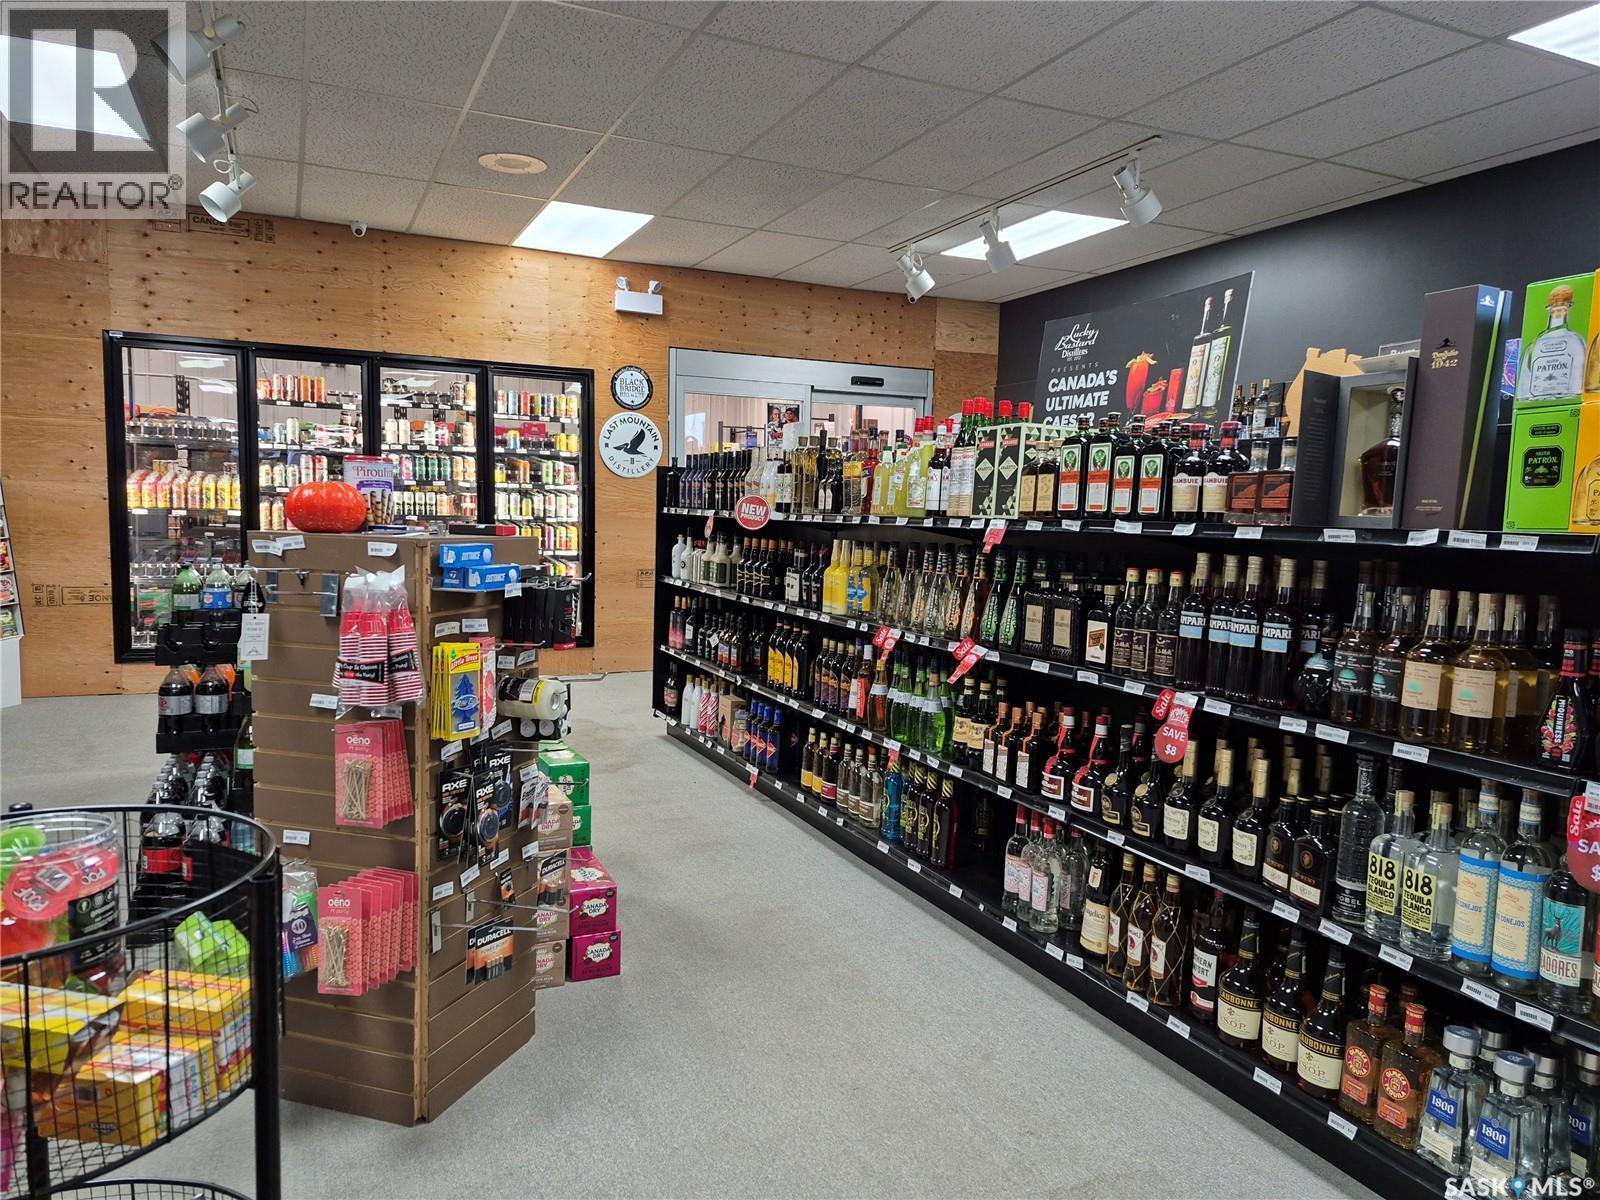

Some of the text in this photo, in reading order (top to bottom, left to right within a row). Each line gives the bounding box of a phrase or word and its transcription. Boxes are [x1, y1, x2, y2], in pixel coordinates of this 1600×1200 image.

[1070, 322, 1099, 340] Lucky
[1054, 333, 1098, 351] Bastard
[1061, 347, 1088, 358] Distillers
[1051, 361, 1099, 373] PRESENTS
[619, 377, 645, 386] BLACK
[1047, 369, 1118, 393] CANADA'S
[1045, 390, 1110, 412] ULTIMATE
[1042, 411, 1096, 427] CAESR
[602, 416, 660, 442] LAST MOUNTAIN
[608, 455, 656, 475] DISTILLERY
[740, 512, 765, 522] PRODUCT
[741, 502, 767, 516] NEW
[876, 628, 889, 644] Sale
[956, 640, 972, 659] Sale
[1155, 692, 1171, 717] Sale
[1162, 726, 1187, 742] SAVE
[1164, 743, 1177, 756] $8
[489, 755, 511, 768] AXE
[442, 779, 468, 792] AXE
[476, 783, 494, 799] AXE
[1569, 799, 1583, 837] Sale
[1369, 854, 1396, 880] 818
[1367, 882, 1395, 900] BLANCO
[1368, 874, 1395, 891] TEQUILA
[1405, 869, 1433, 896] 818
[583, 902, 608, 911] CANADA
[1402, 898, 1431, 916] BLANCO
[1403, 889, 1432, 908] TEQUILA
[477, 929, 512, 946] DURACELL
[587, 946, 611, 955] CANADA
[1431, 1095, 1455, 1115] 1800
[1481, 1123, 1507, 1146] 1800
